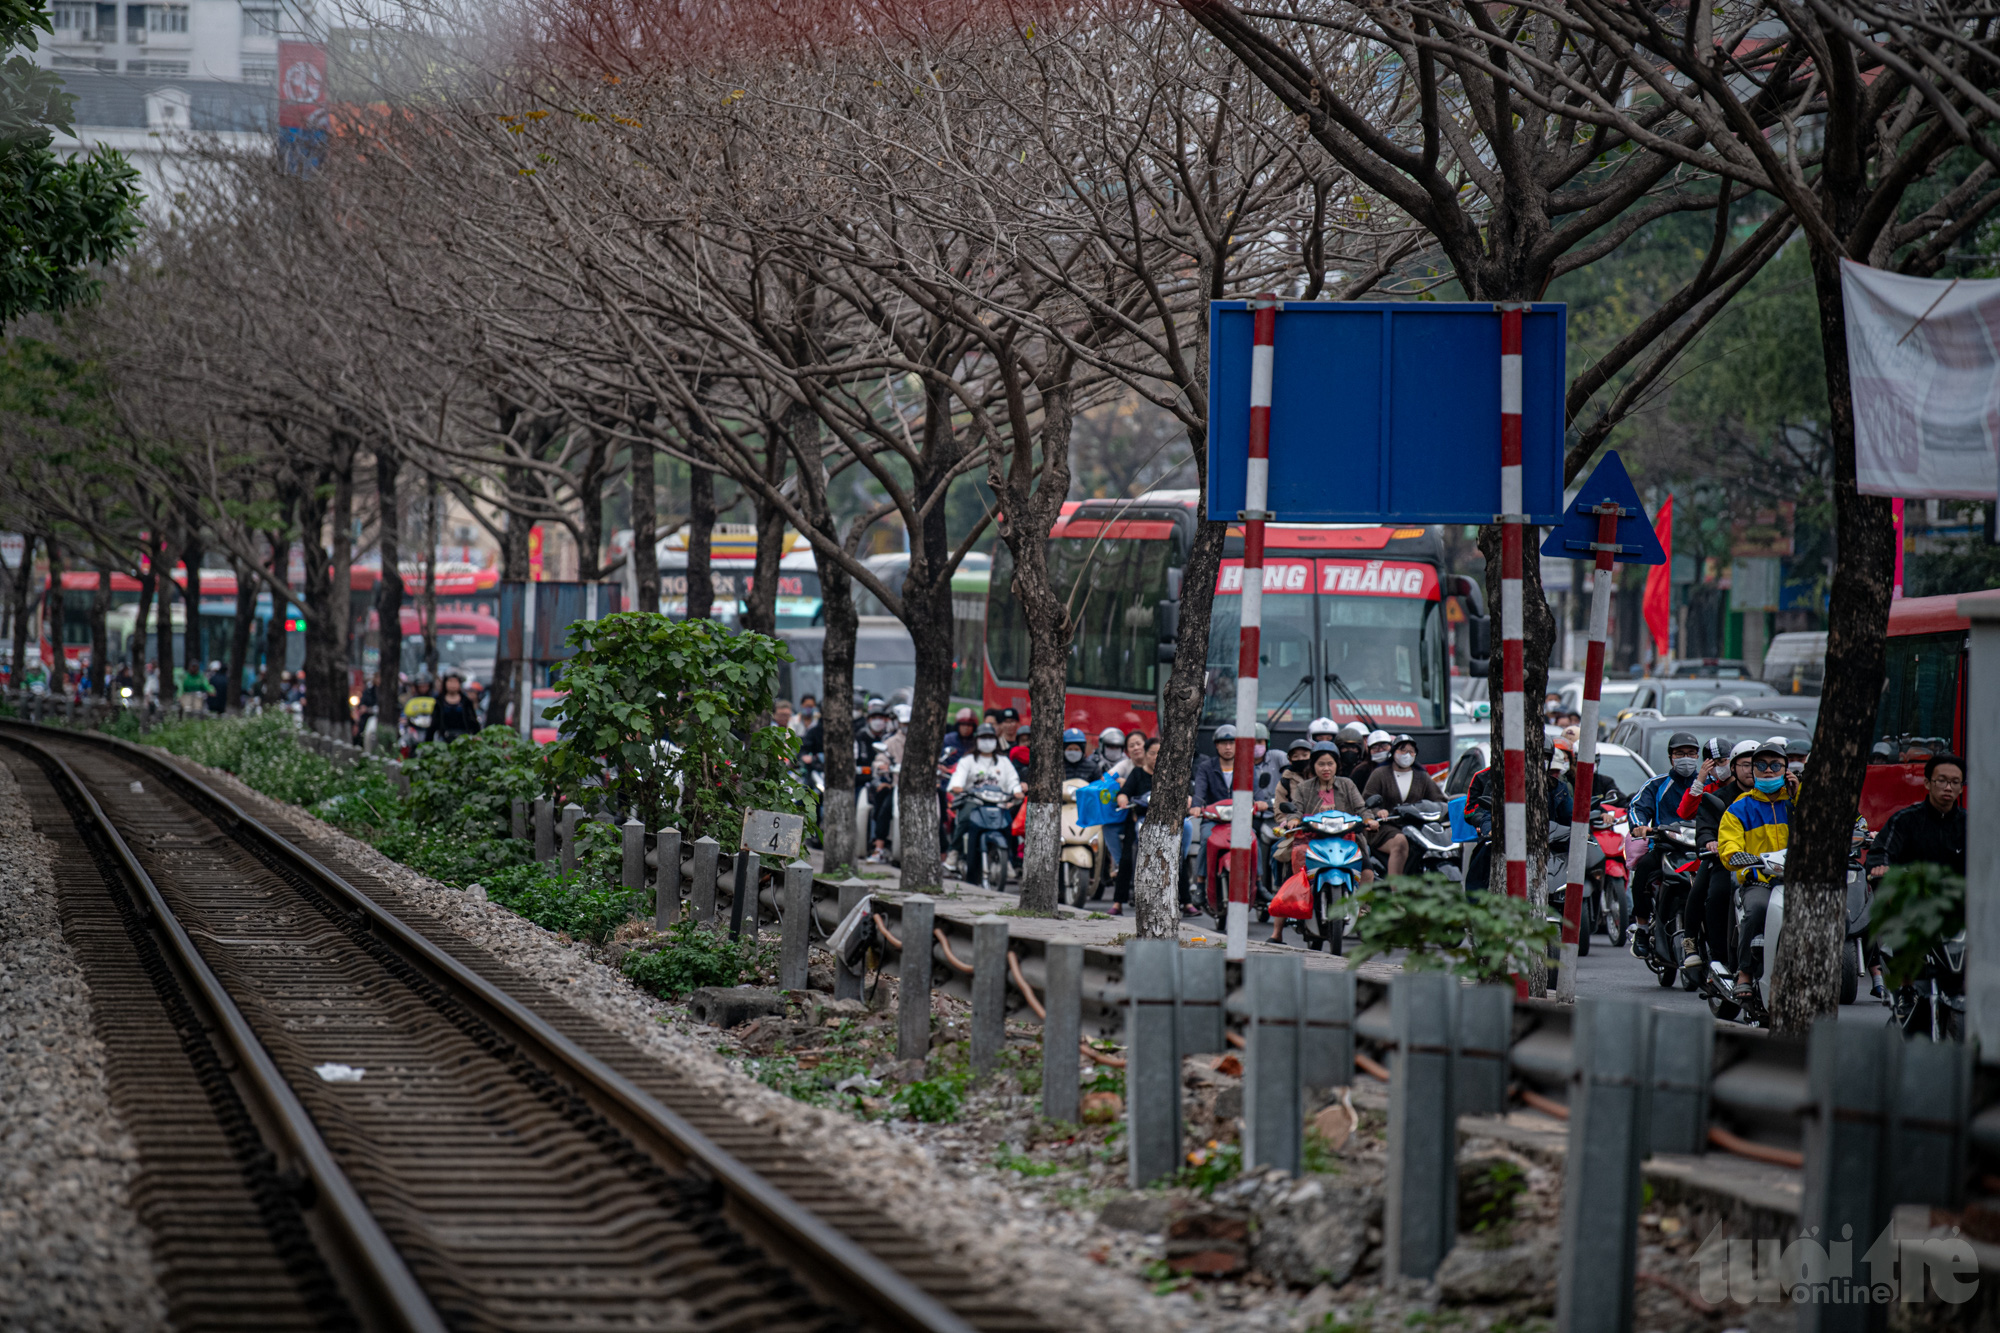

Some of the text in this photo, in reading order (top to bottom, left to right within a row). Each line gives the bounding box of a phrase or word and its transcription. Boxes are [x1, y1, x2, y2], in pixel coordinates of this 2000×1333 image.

[1218, 560, 1424, 595] HNG THẮNG
[1385, 703, 1416, 718] HÓA
[772, 816, 780, 829] 6
[769, 832, 779, 851] 4
